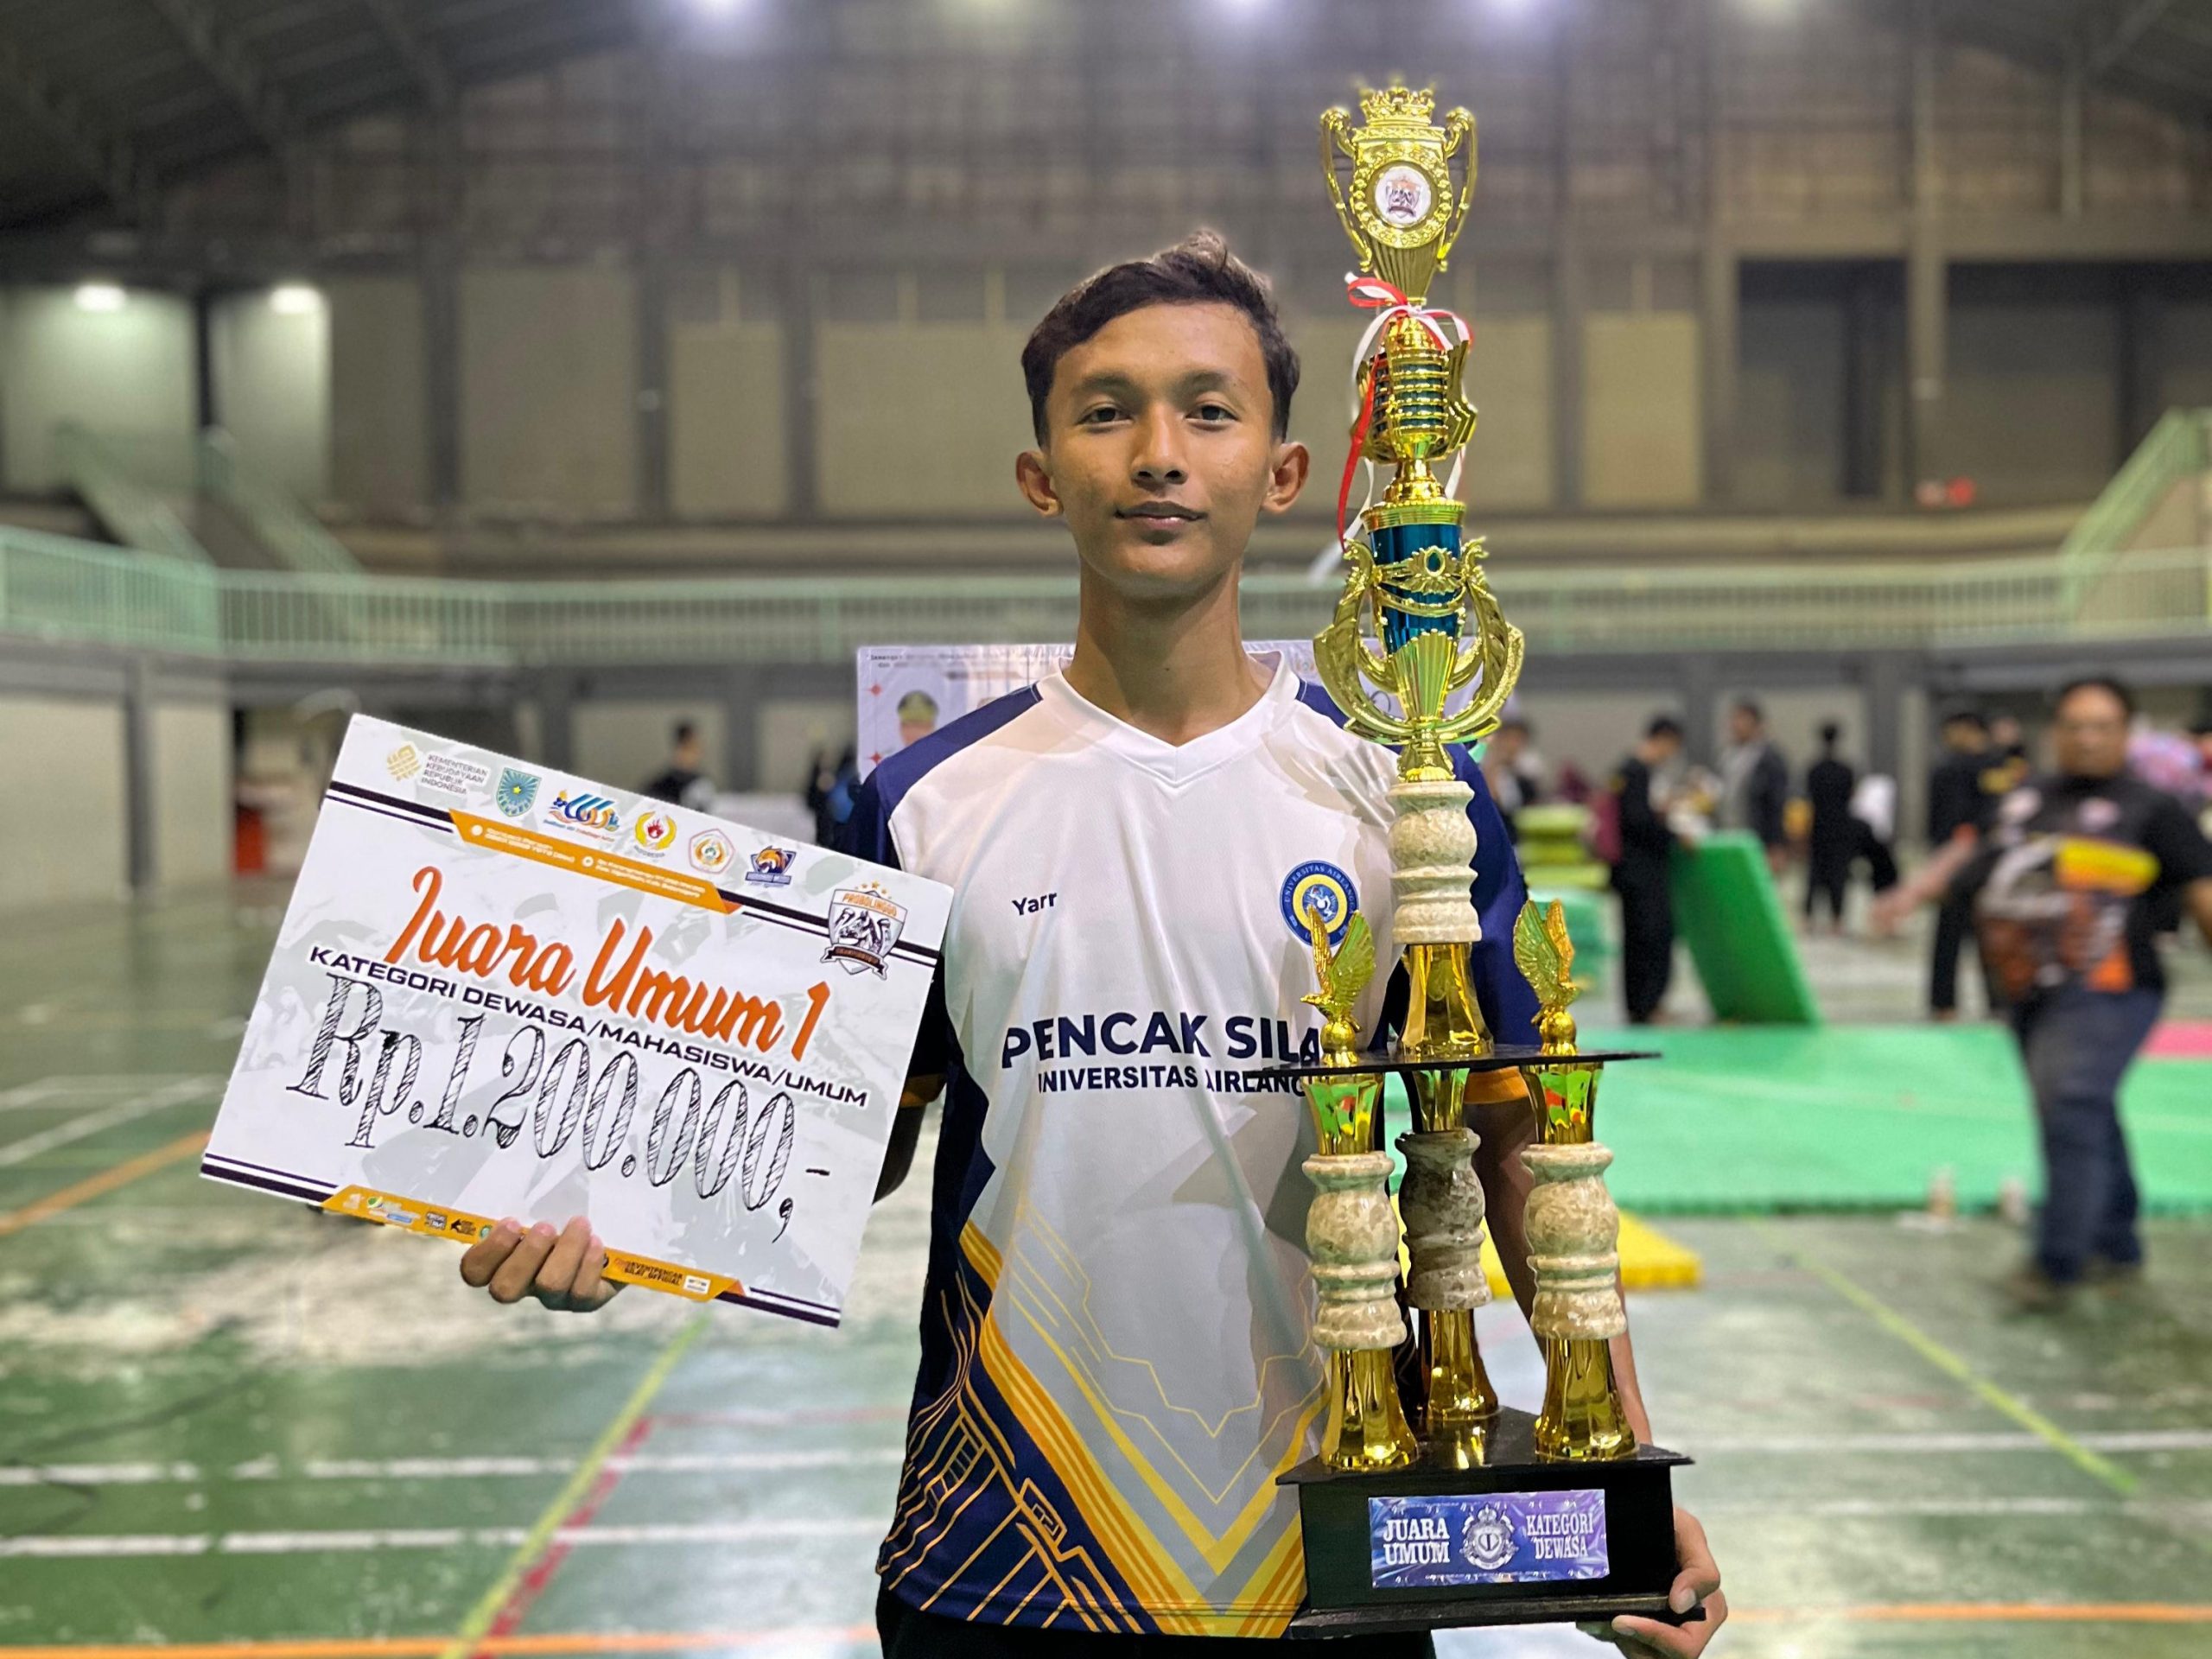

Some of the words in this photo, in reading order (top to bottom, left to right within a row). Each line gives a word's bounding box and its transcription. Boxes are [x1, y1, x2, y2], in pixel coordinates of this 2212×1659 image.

[423, 769, 464, 785] REPUBLIK
[426, 762, 485, 784] KEBUDAYAAN
[428, 754, 489, 776] KEMENTERIAN
[421, 777, 467, 795] INDONESIA
[1011, 893, 1058, 917] Yarr
[384, 866, 577, 997] Juara
[582, 918, 785, 1053] Umum
[791, 981, 831, 1063] 1
[309, 946, 458, 998] KATEGORI
[462, 987, 868, 1107] DEWASA/MAHASISWA/UMUM
[1001, 1011, 1211, 1069] PENCAK
[1225, 1015, 1321, 1067] SILA
[1383, 1517, 1451, 1542] JUARA
[1526, 1513, 1594, 1536] KATEGORI
[1383, 1541, 1451, 1566] UMUM
[1534, 1536, 1589, 1560] DEWASA
